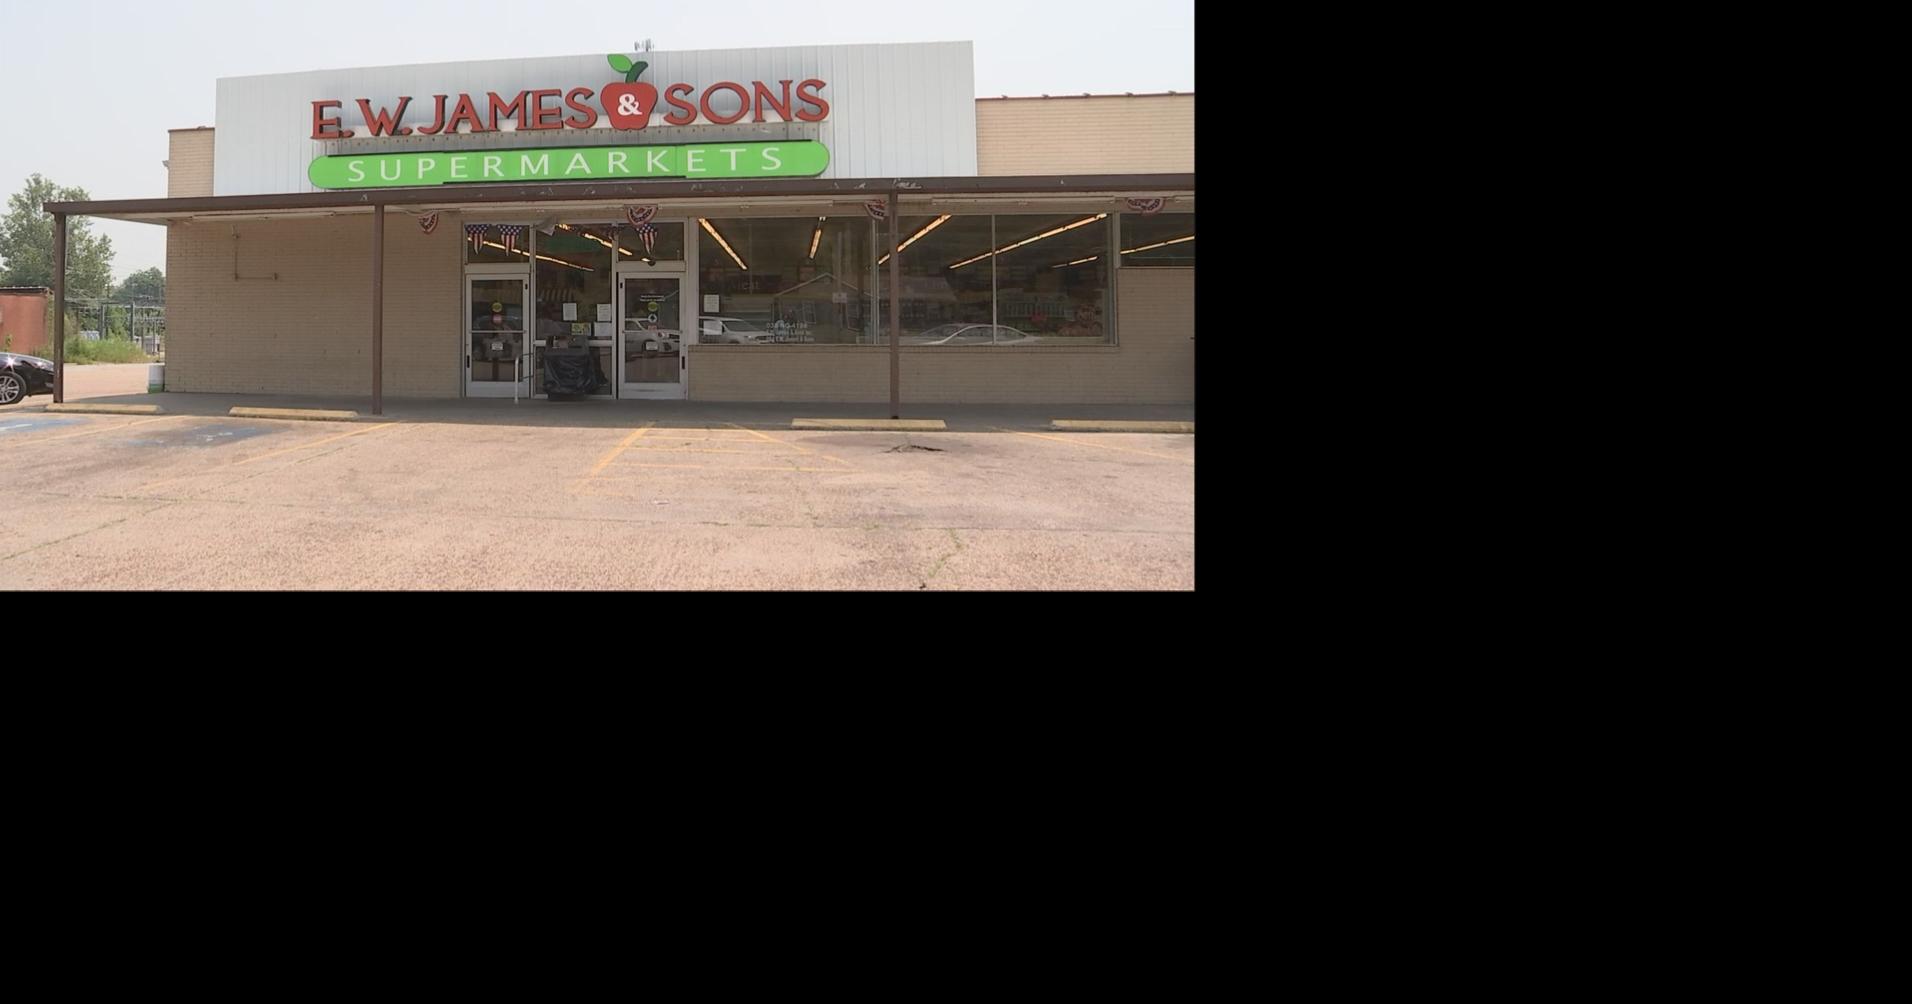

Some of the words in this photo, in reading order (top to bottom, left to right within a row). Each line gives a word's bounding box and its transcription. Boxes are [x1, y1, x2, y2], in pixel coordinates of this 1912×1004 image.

[417, 87, 597, 135] JAMES
[617, 93, 643, 116] &
[663, 79, 829, 126] SONS
[348, 147, 782, 182] SUPERMARKETS
